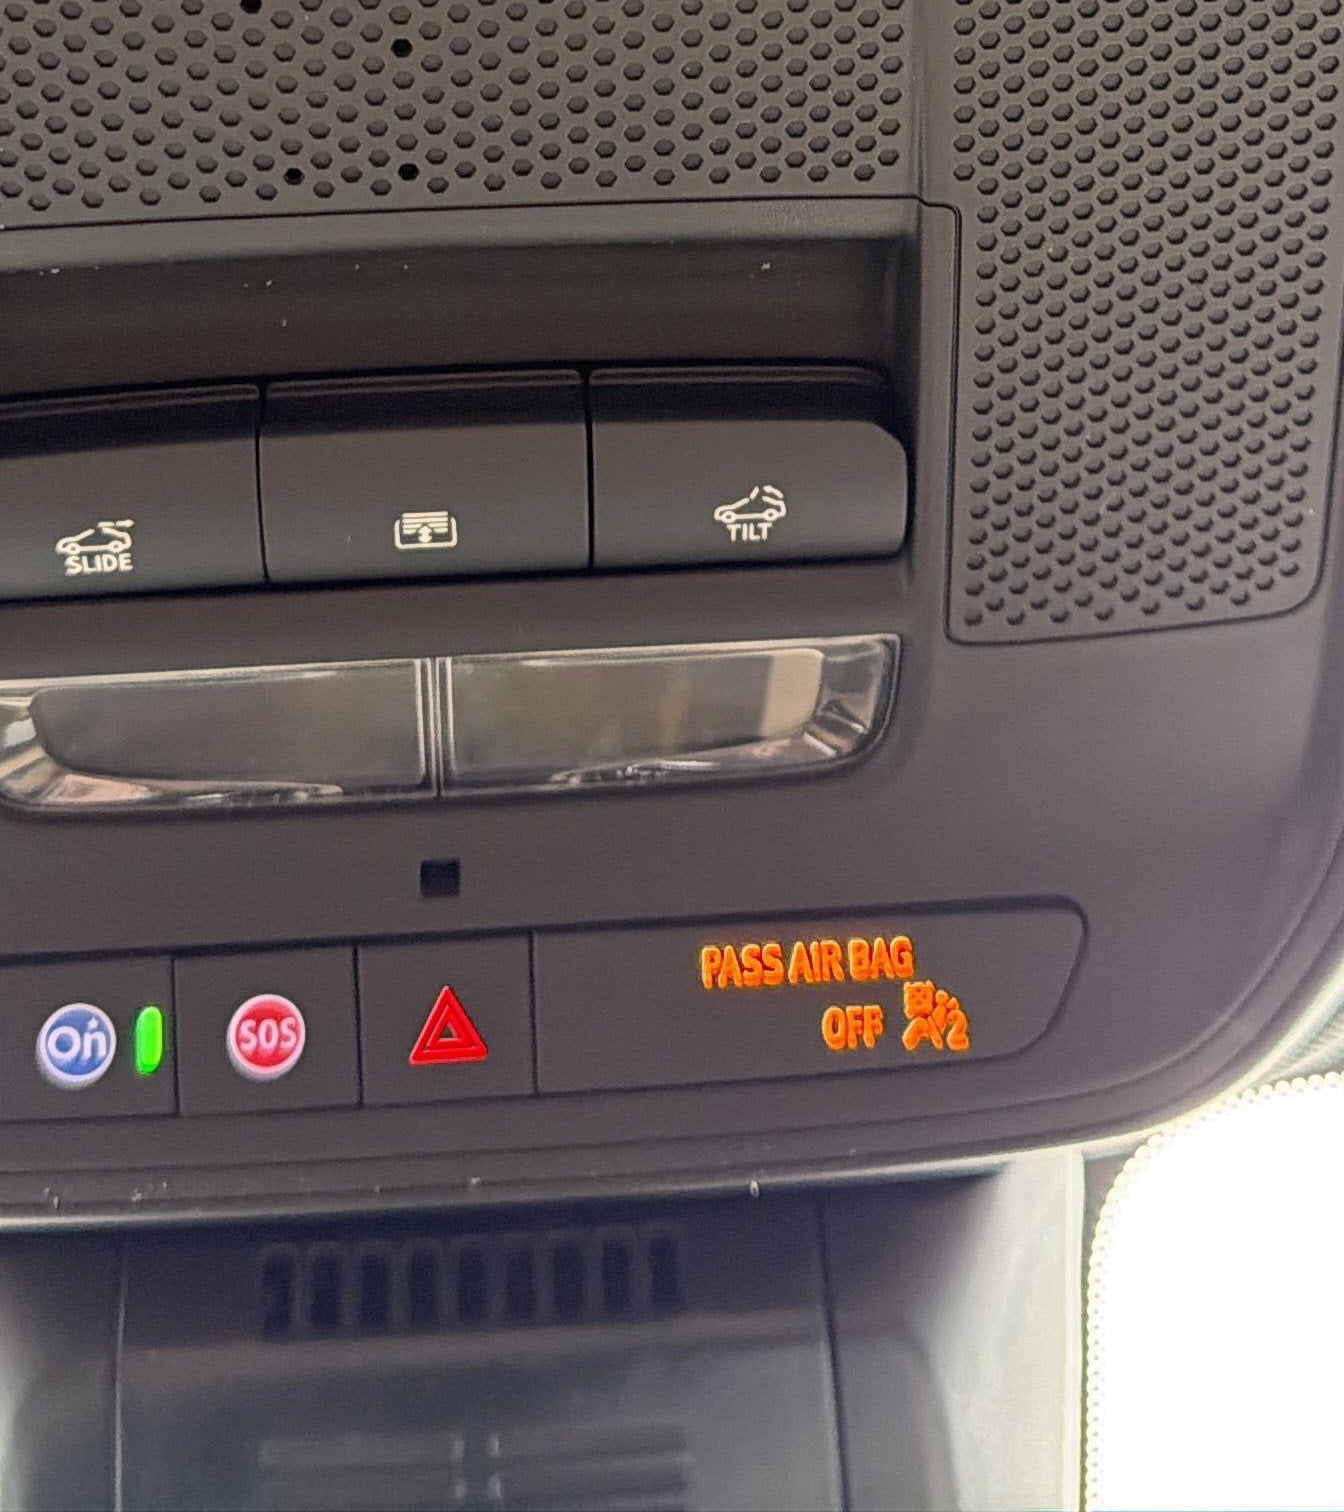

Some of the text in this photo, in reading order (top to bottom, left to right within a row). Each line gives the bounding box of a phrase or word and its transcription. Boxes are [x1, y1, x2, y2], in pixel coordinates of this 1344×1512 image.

[727, 523, 772, 541] TILT
[65, 552, 133, 574] SLIDE
[701, 936, 914, 988] PASS AIR BAG
[240, 1017, 297, 1050] SOS
[822, 1005, 884, 1050] OFF
